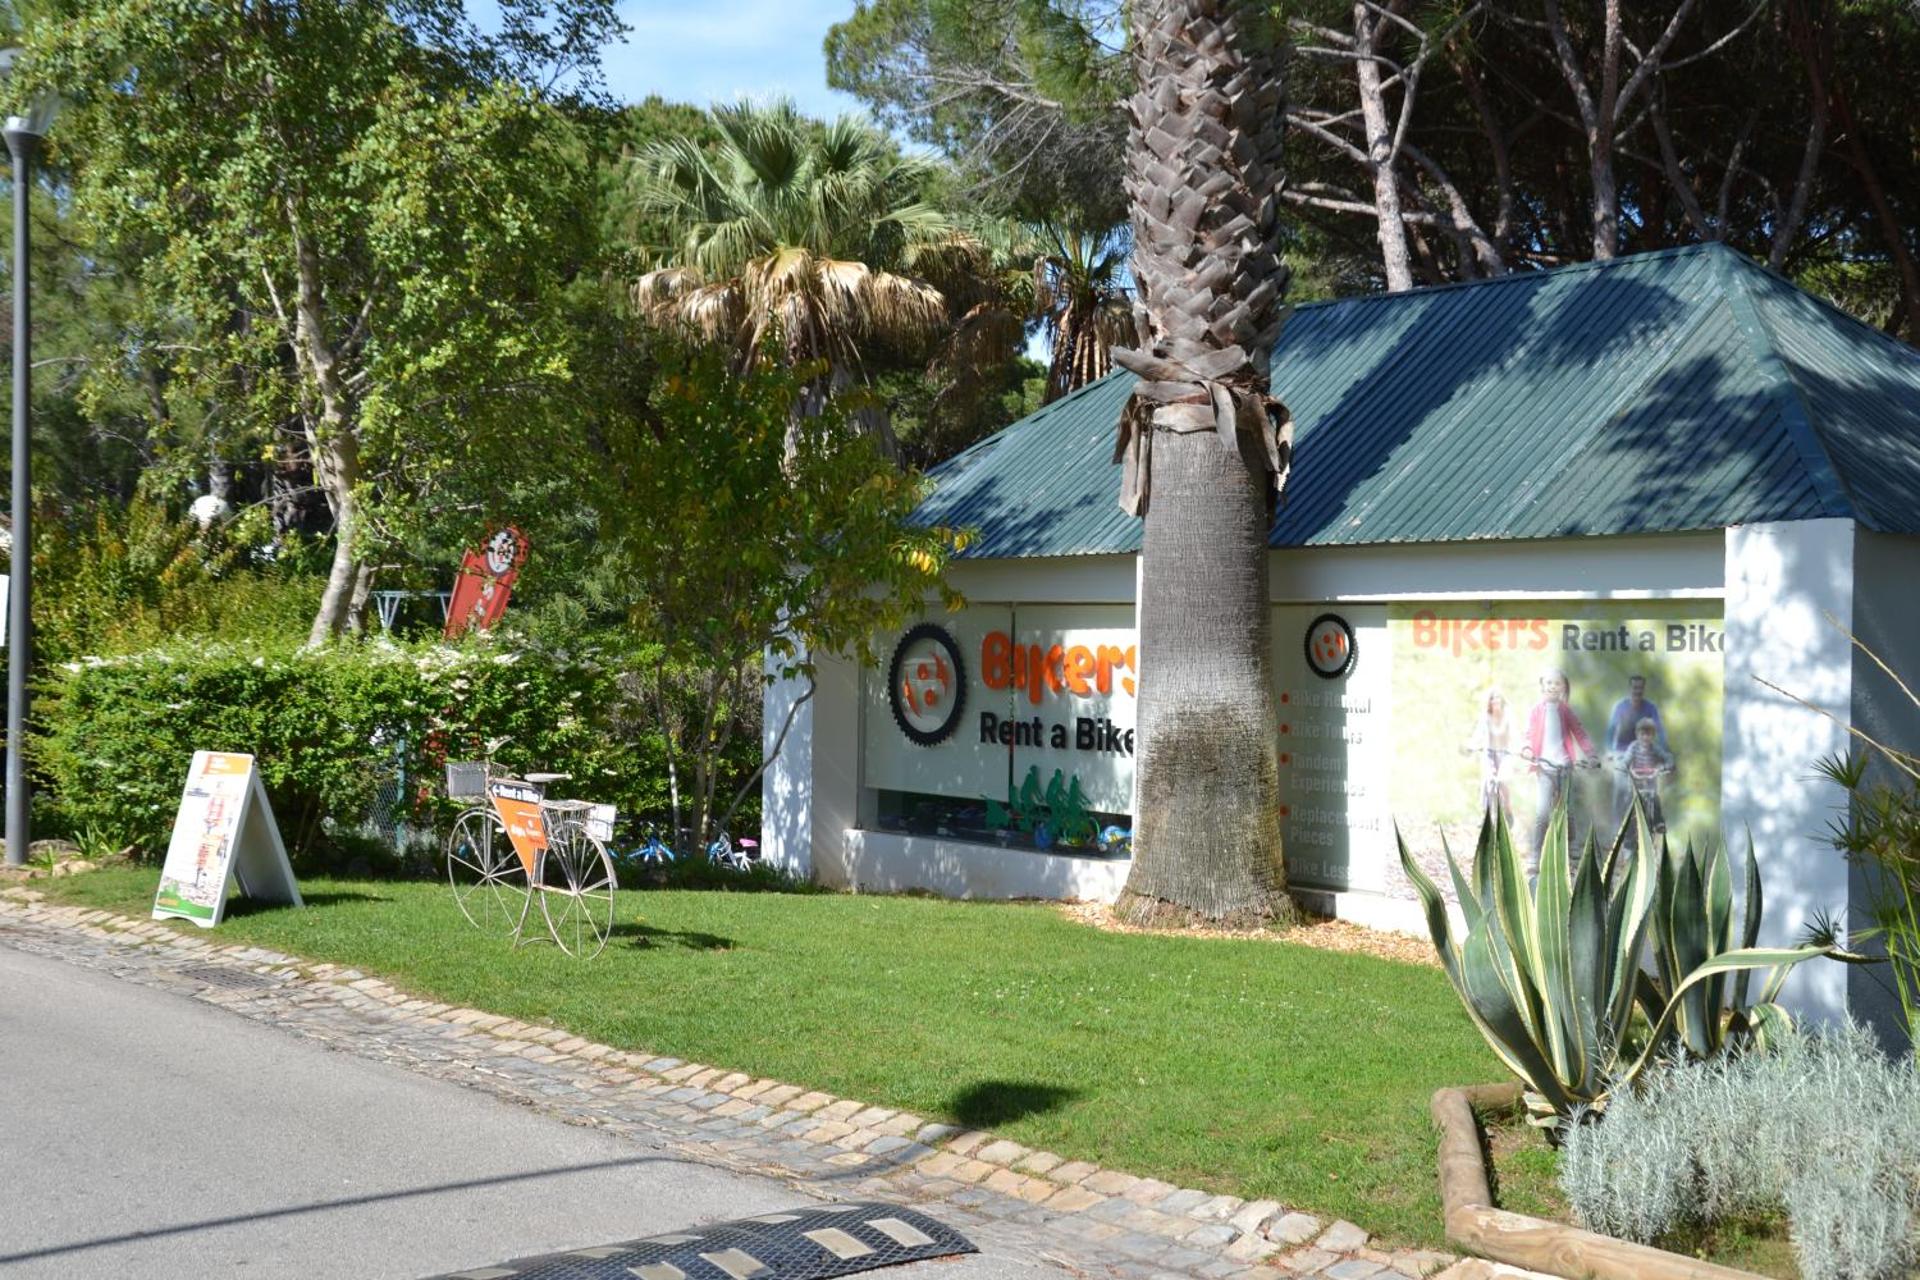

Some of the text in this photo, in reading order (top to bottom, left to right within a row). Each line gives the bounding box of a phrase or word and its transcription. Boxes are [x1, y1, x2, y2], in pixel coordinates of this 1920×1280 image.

[1412, 608, 1549, 658] Bikers
[1562, 623, 1629, 651] Rent
[1639, 631, 1655, 651] a
[980, 711, 1043, 747] Rent
[1050, 722, 1067, 749] a
[1290, 826, 1334, 847] Pieces
